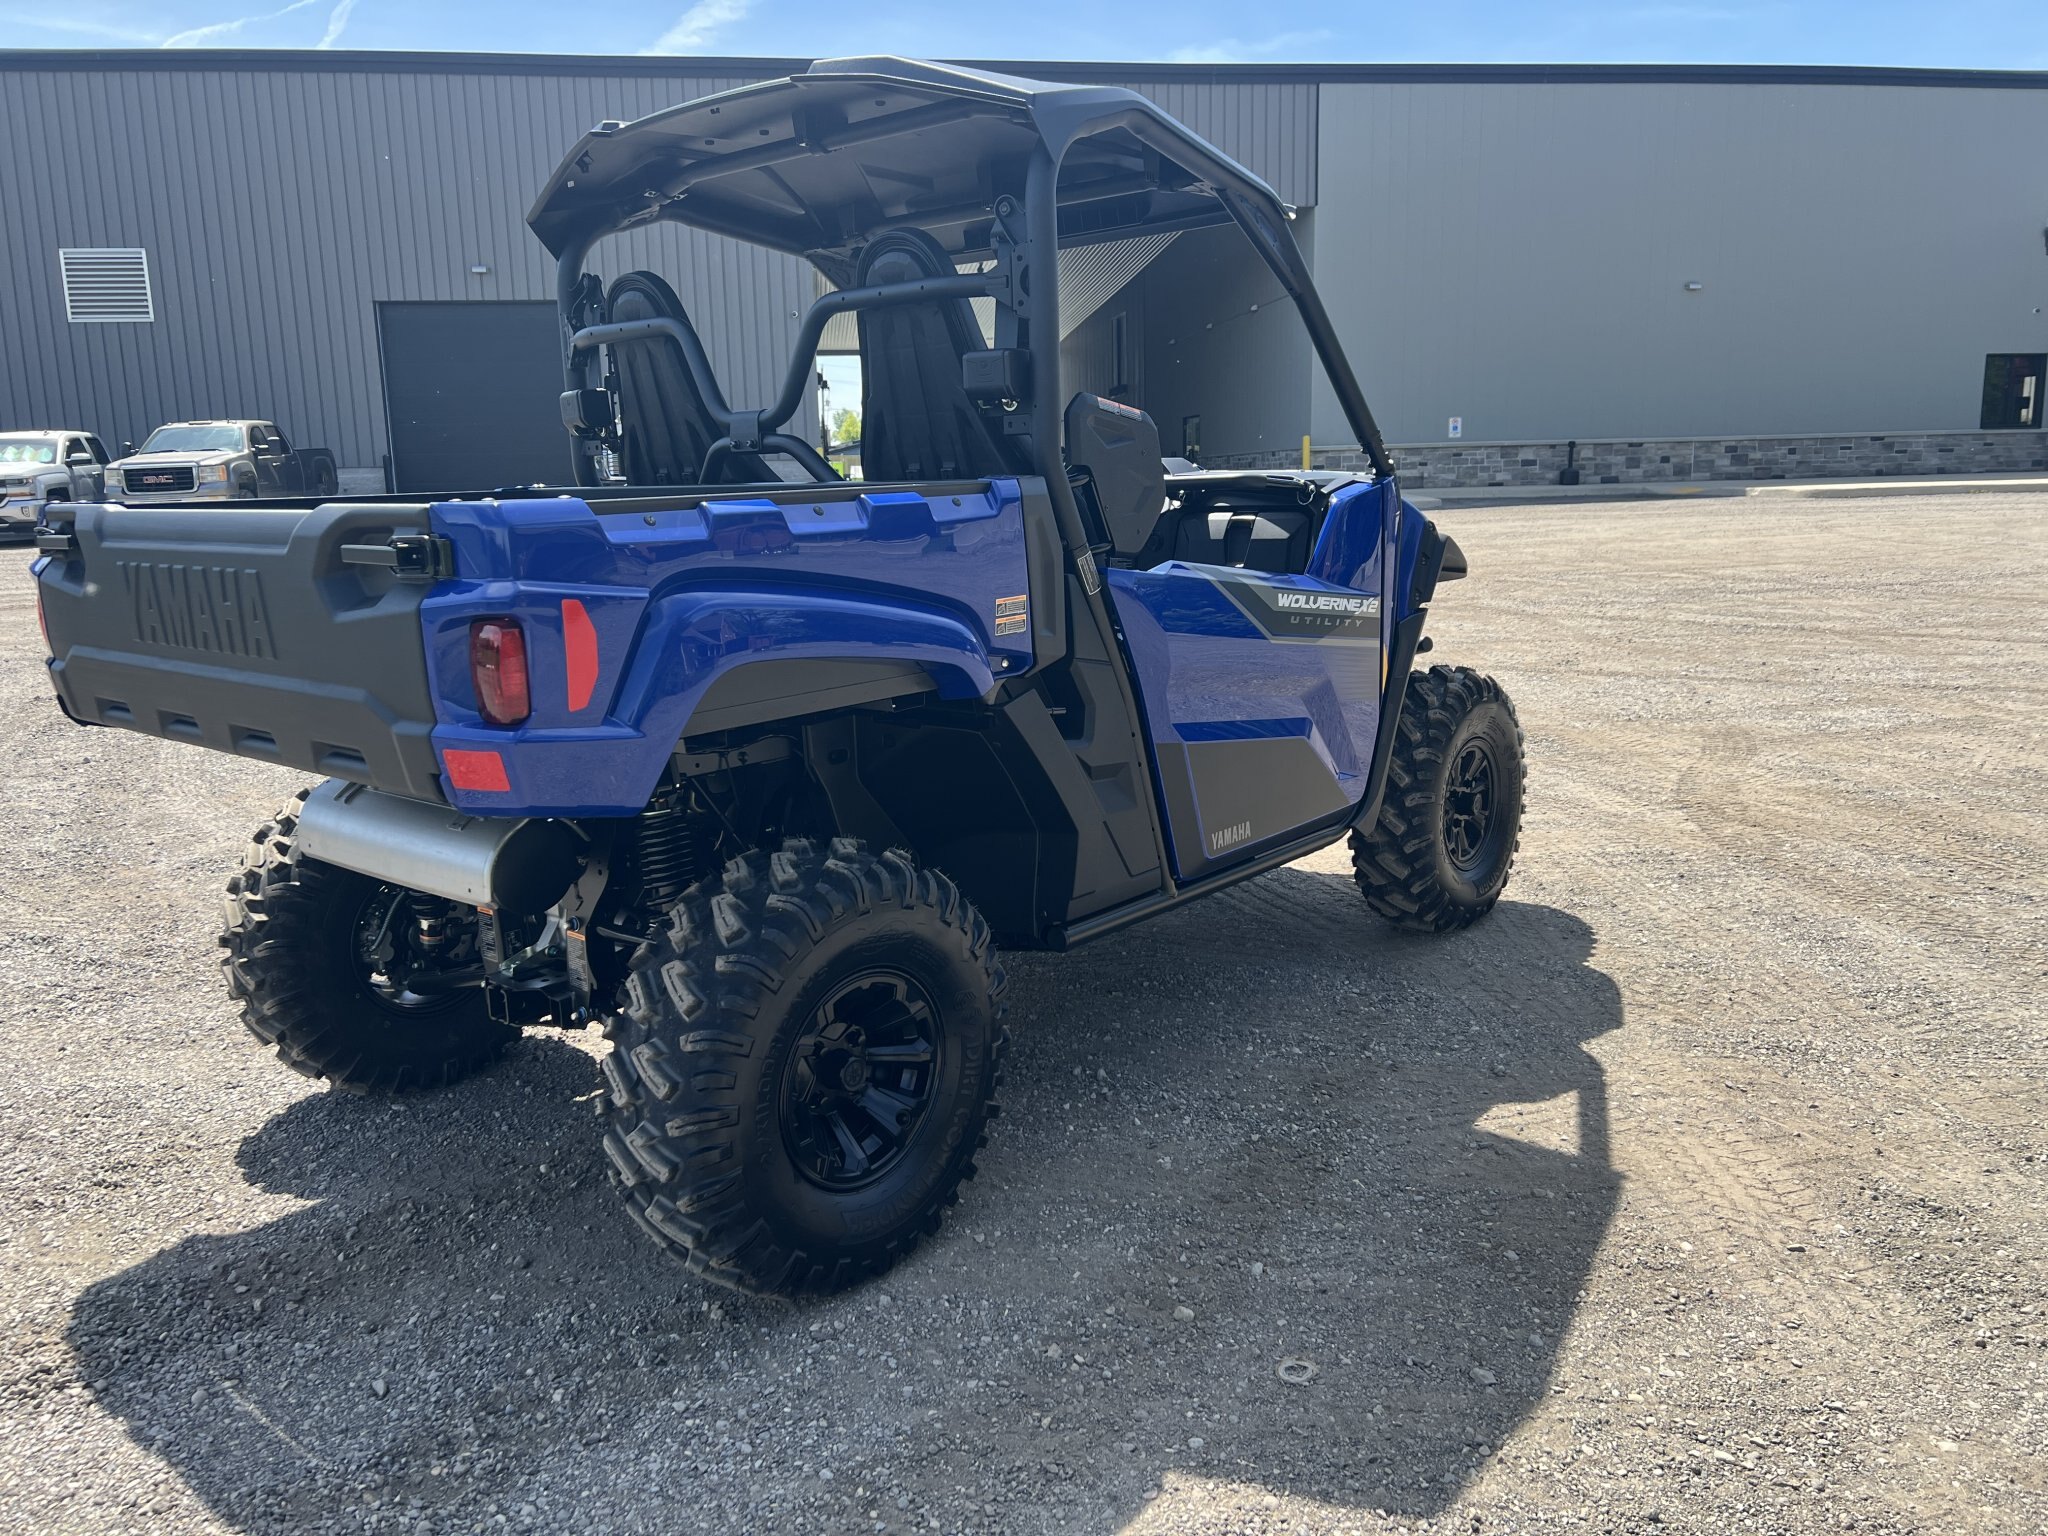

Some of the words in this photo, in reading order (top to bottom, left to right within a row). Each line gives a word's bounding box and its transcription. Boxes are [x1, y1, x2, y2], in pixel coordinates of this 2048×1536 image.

[143, 475, 174, 484] GMC
[116, 561, 278, 661] YAMAHA
[1290, 615, 1363, 627] UTILITY
[1211, 820, 1251, 850] YAMAHA
